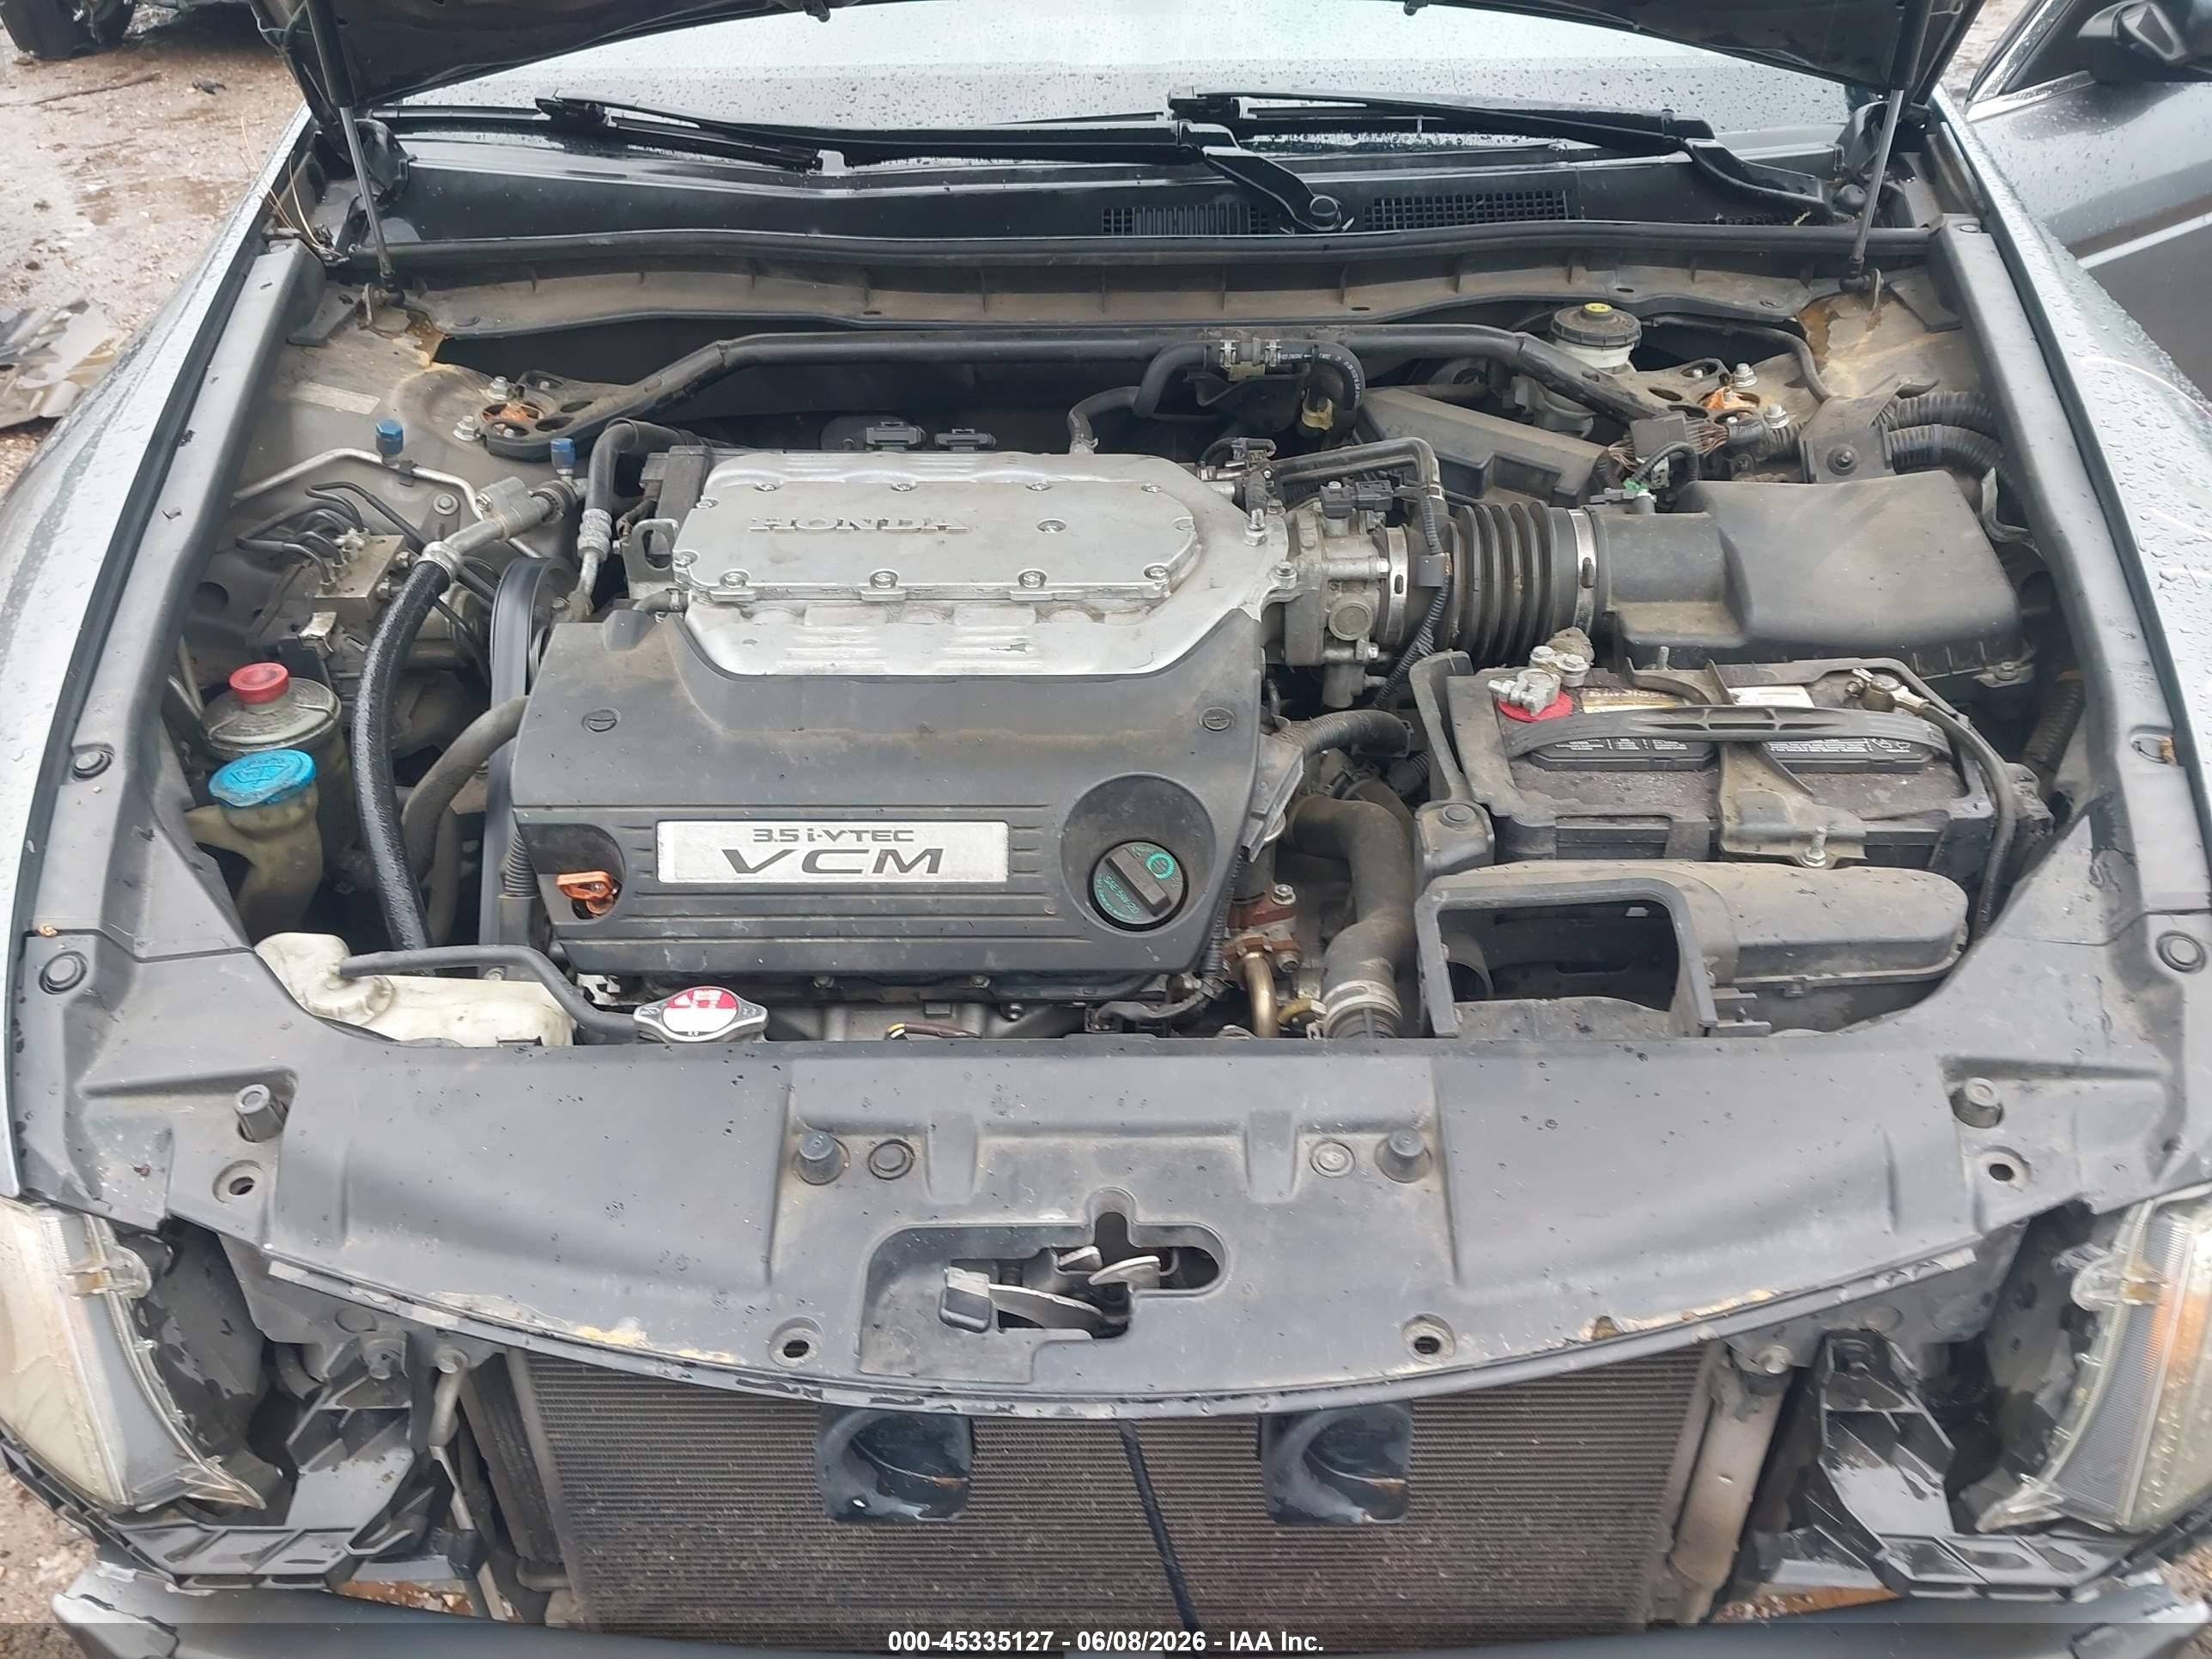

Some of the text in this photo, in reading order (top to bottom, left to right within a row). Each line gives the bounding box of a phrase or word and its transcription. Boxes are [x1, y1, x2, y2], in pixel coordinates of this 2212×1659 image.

[749, 517, 969, 533] HONDA
[753, 828, 915, 842] 3.5 i-VTEC
[721, 848, 944, 874] VCM
